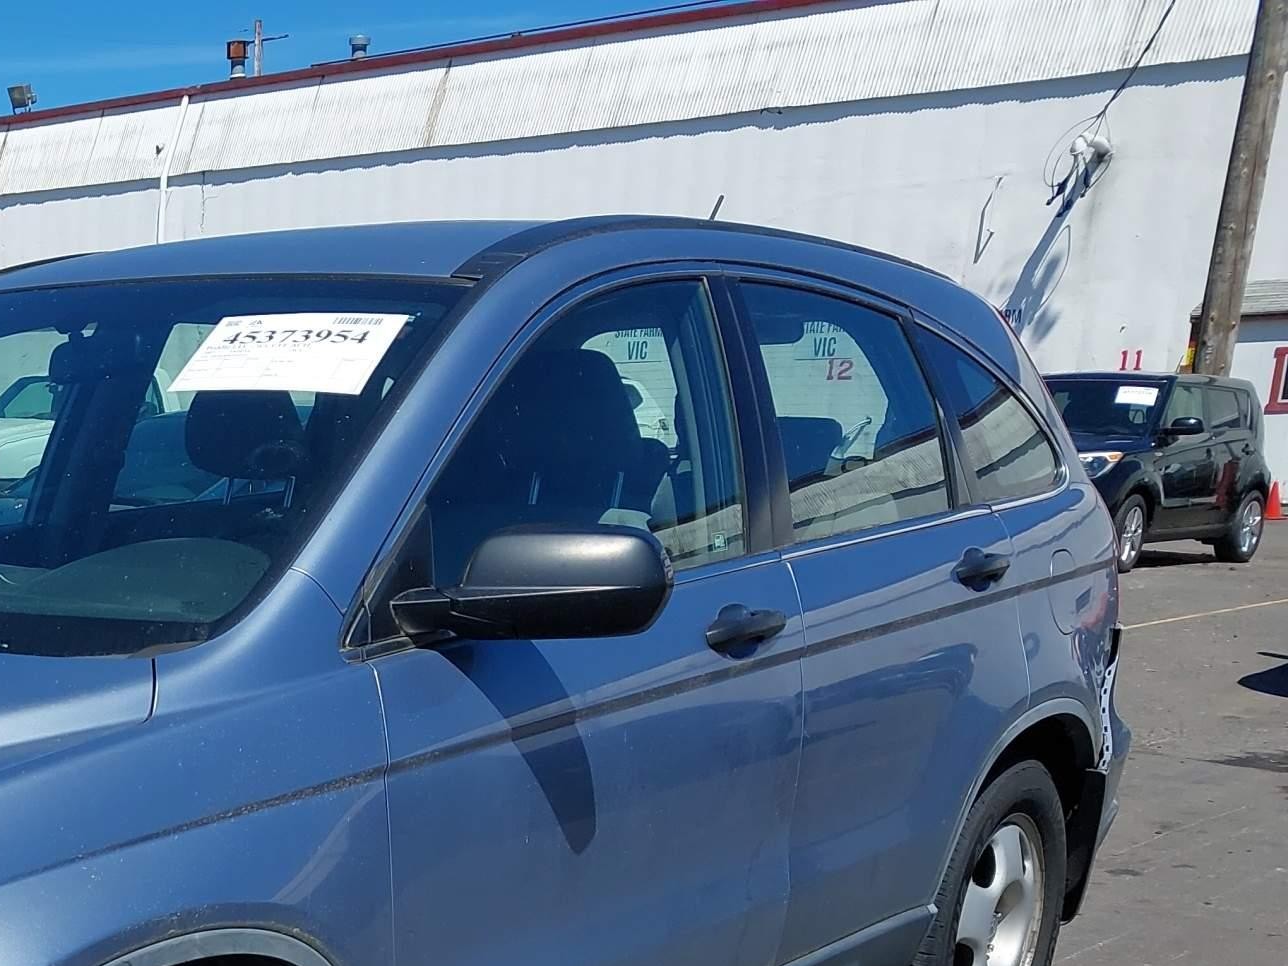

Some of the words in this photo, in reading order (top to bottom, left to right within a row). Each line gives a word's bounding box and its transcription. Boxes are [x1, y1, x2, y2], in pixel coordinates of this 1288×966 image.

[223, 329, 371, 345] 45373954
[814, 337, 837, 357] VIC
[627, 340, 648, 361] VIC
[1119, 349, 1143, 371] 11
[826, 359, 853, 381] 12
